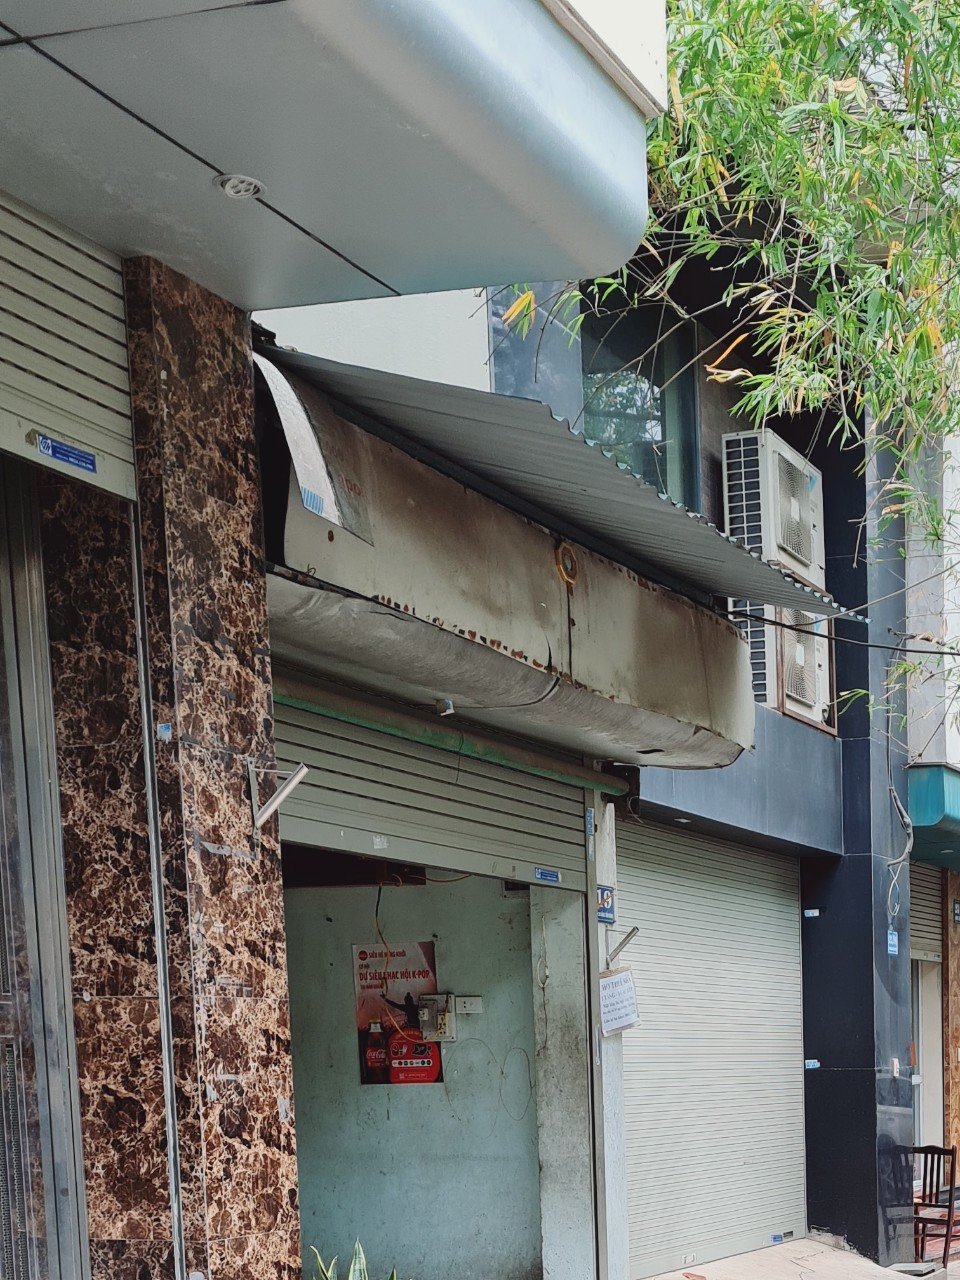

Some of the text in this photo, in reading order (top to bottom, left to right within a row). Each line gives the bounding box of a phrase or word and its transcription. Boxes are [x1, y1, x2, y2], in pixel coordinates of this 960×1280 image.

[359, 971, 368, 983] DỰ
[368, 969, 382, 981] SIÊU
[400, 968, 411, 982] HỘI
[412, 969, 430, 980] K-POP
